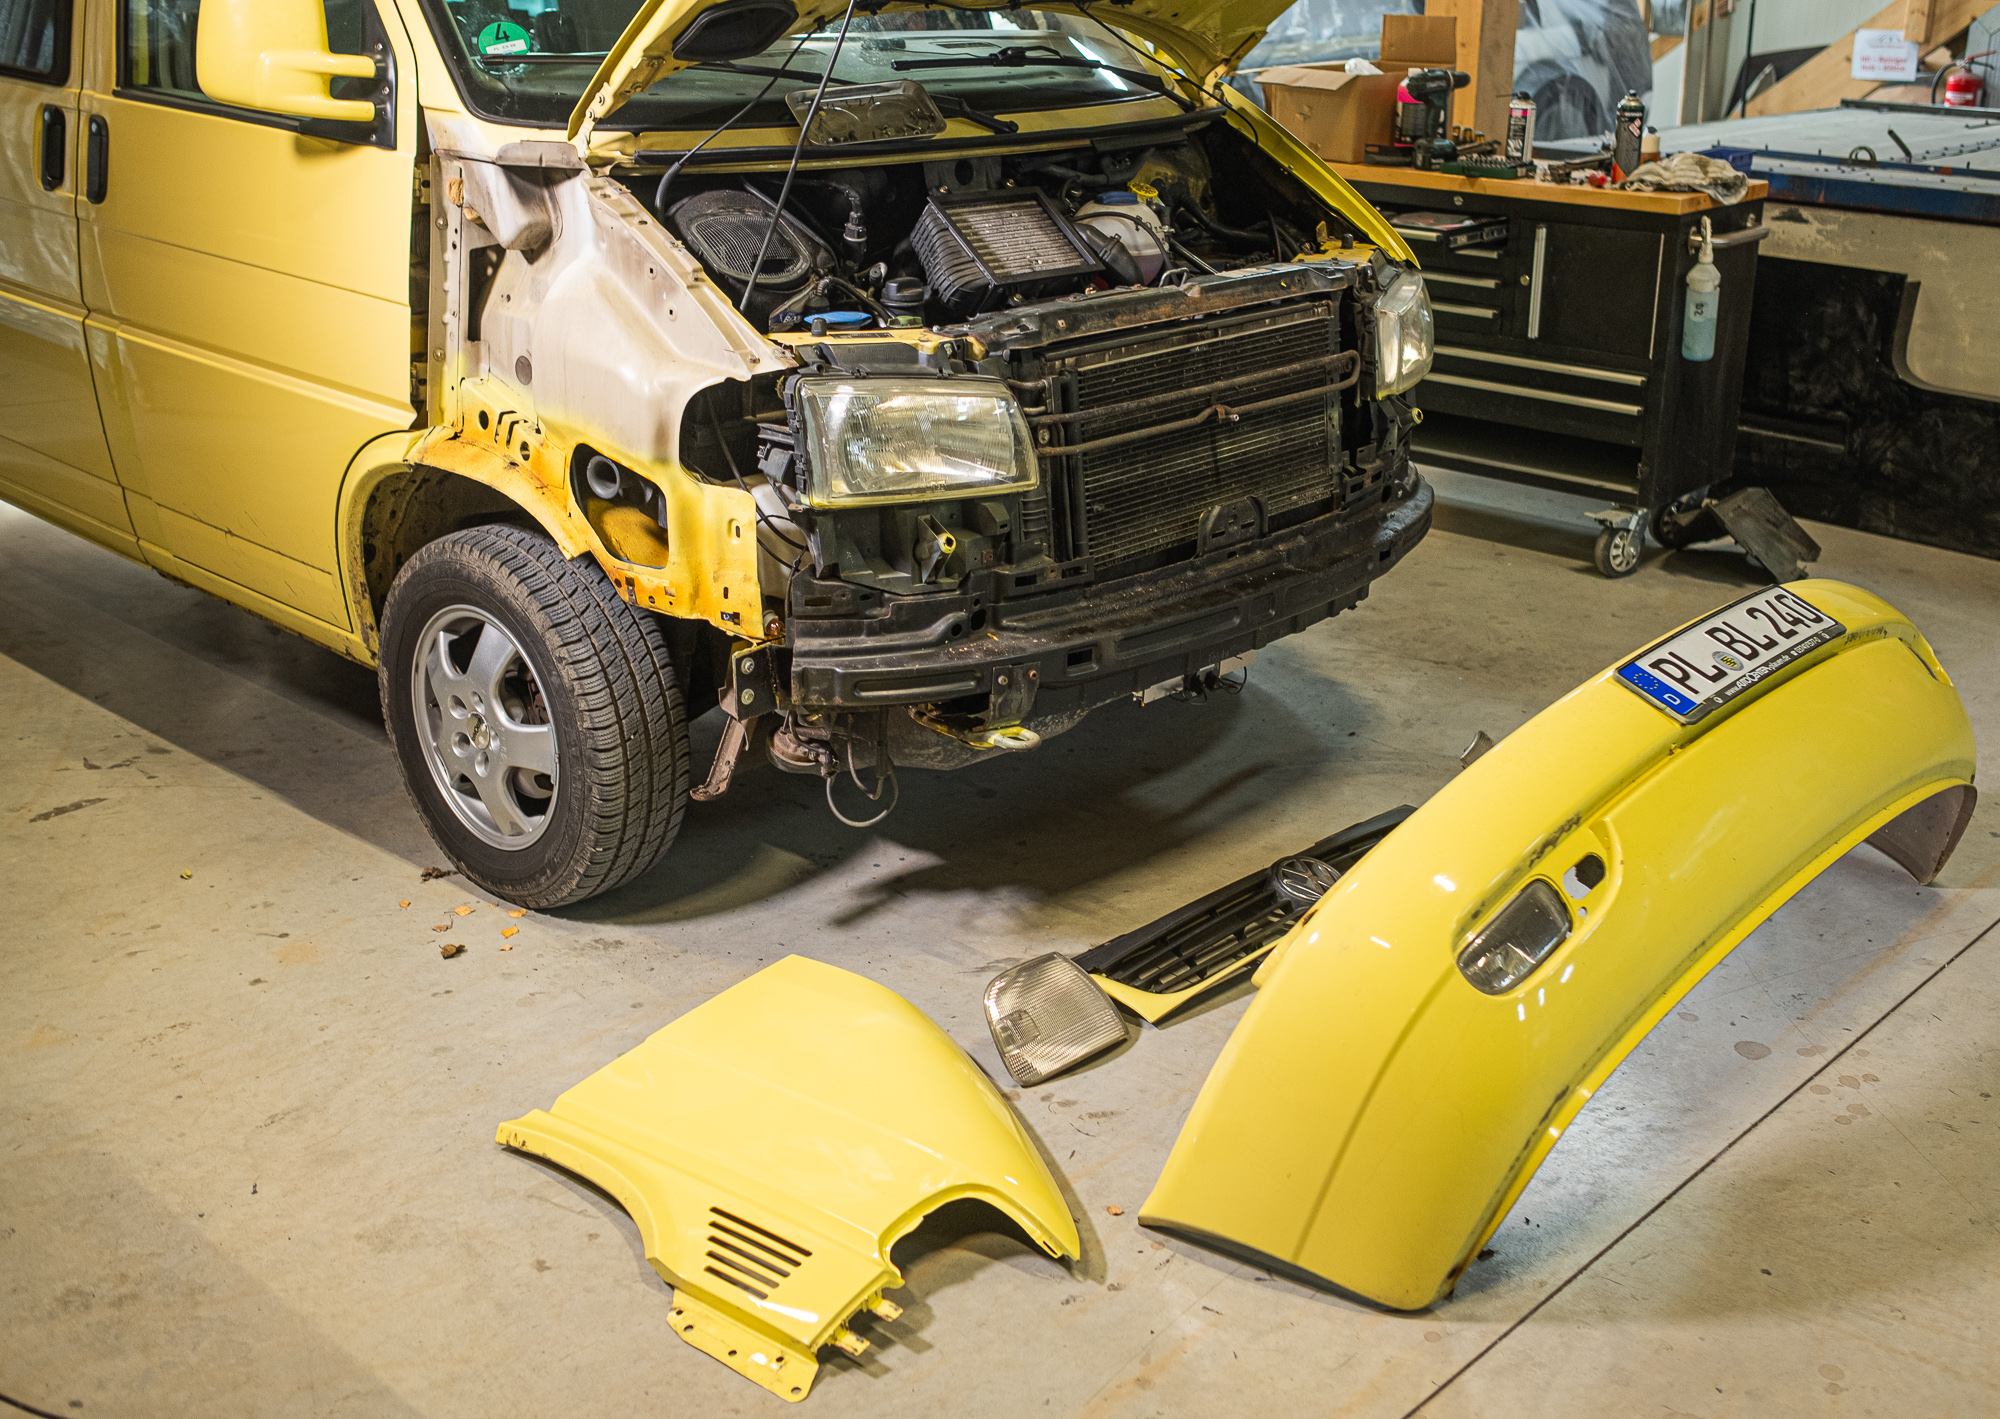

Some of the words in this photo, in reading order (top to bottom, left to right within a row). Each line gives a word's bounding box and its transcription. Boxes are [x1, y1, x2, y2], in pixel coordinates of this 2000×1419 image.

[495, 23, 510, 41] 4
[1648, 651, 1729, 695] PL
[1704, 620, 1779, 662] BL
[1745, 593, 1824, 640] 240
[1663, 694, 1681, 705] D
